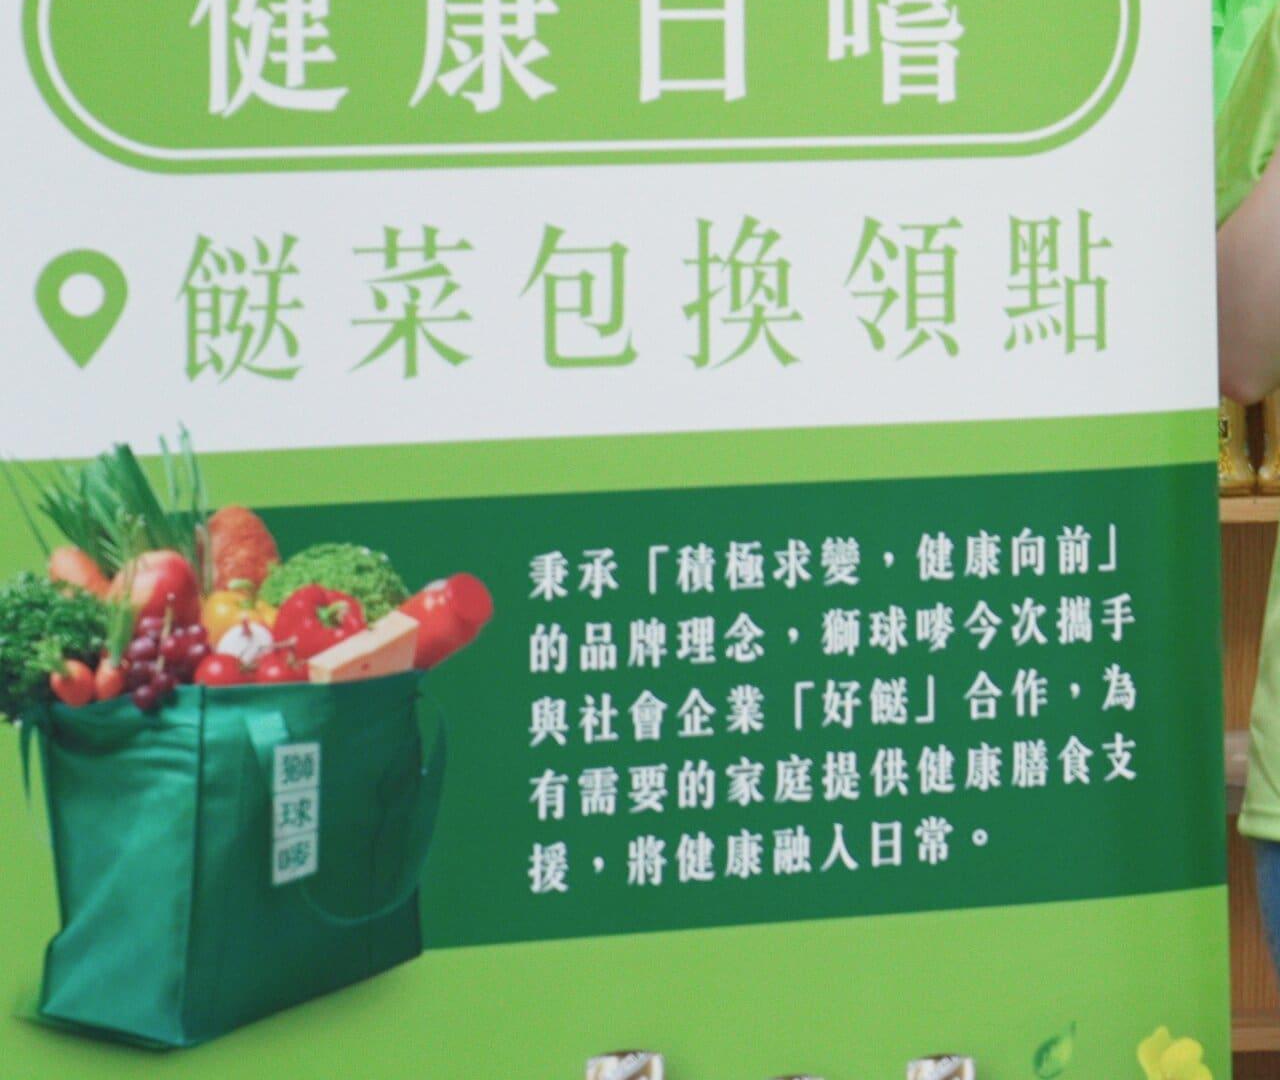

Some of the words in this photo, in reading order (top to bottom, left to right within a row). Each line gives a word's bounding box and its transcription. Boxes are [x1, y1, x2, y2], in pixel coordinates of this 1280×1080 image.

[175, 209, 1114, 384] 餸菜包換領點
